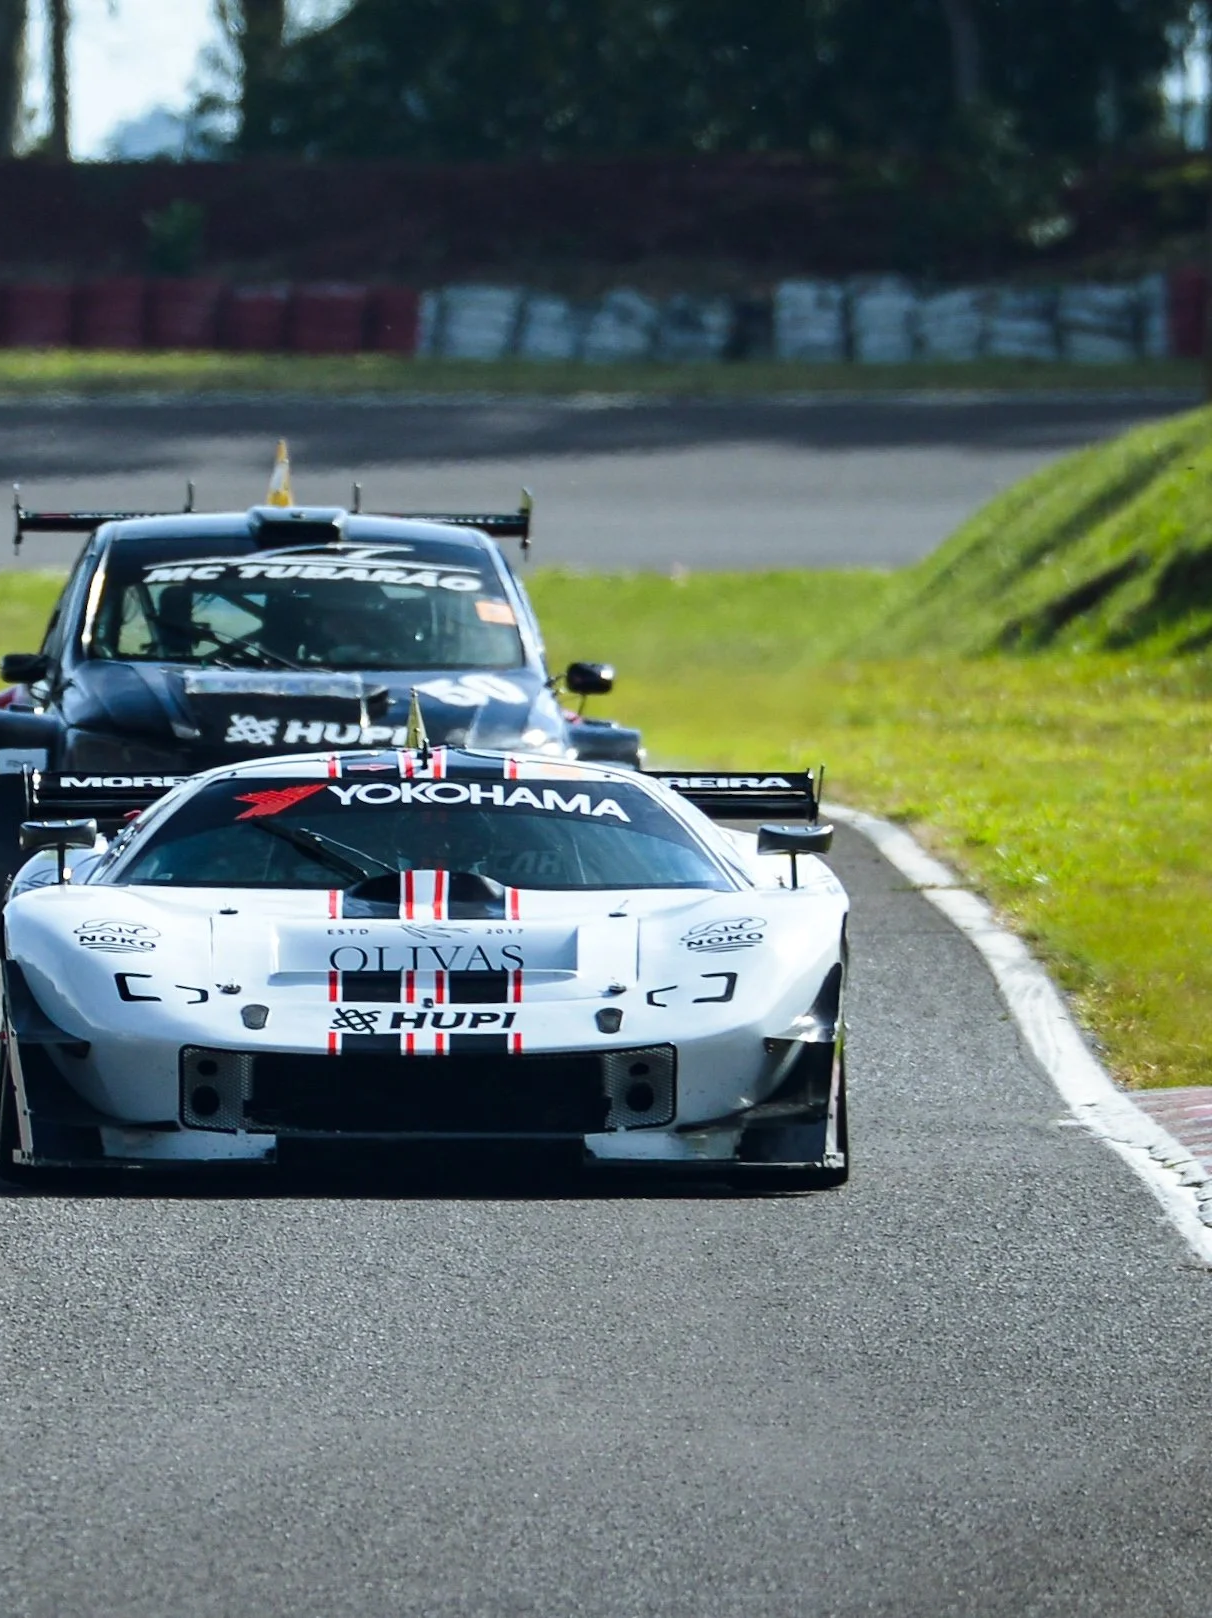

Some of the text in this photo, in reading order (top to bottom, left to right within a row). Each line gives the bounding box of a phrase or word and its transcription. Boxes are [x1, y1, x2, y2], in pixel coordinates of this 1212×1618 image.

[143, 564, 482, 592] MC TUBARÃO
[326, 782, 632, 823] YOKOHAMA
[327, 927, 370, 936] ESTD
[486, 927, 525, 935] 2017
[79, 935, 156, 949] NOKO
[686, 932, 764, 948] NOKO
[328, 943, 524, 972] OLIVAS
[389, 1011, 517, 1030] HUPI
